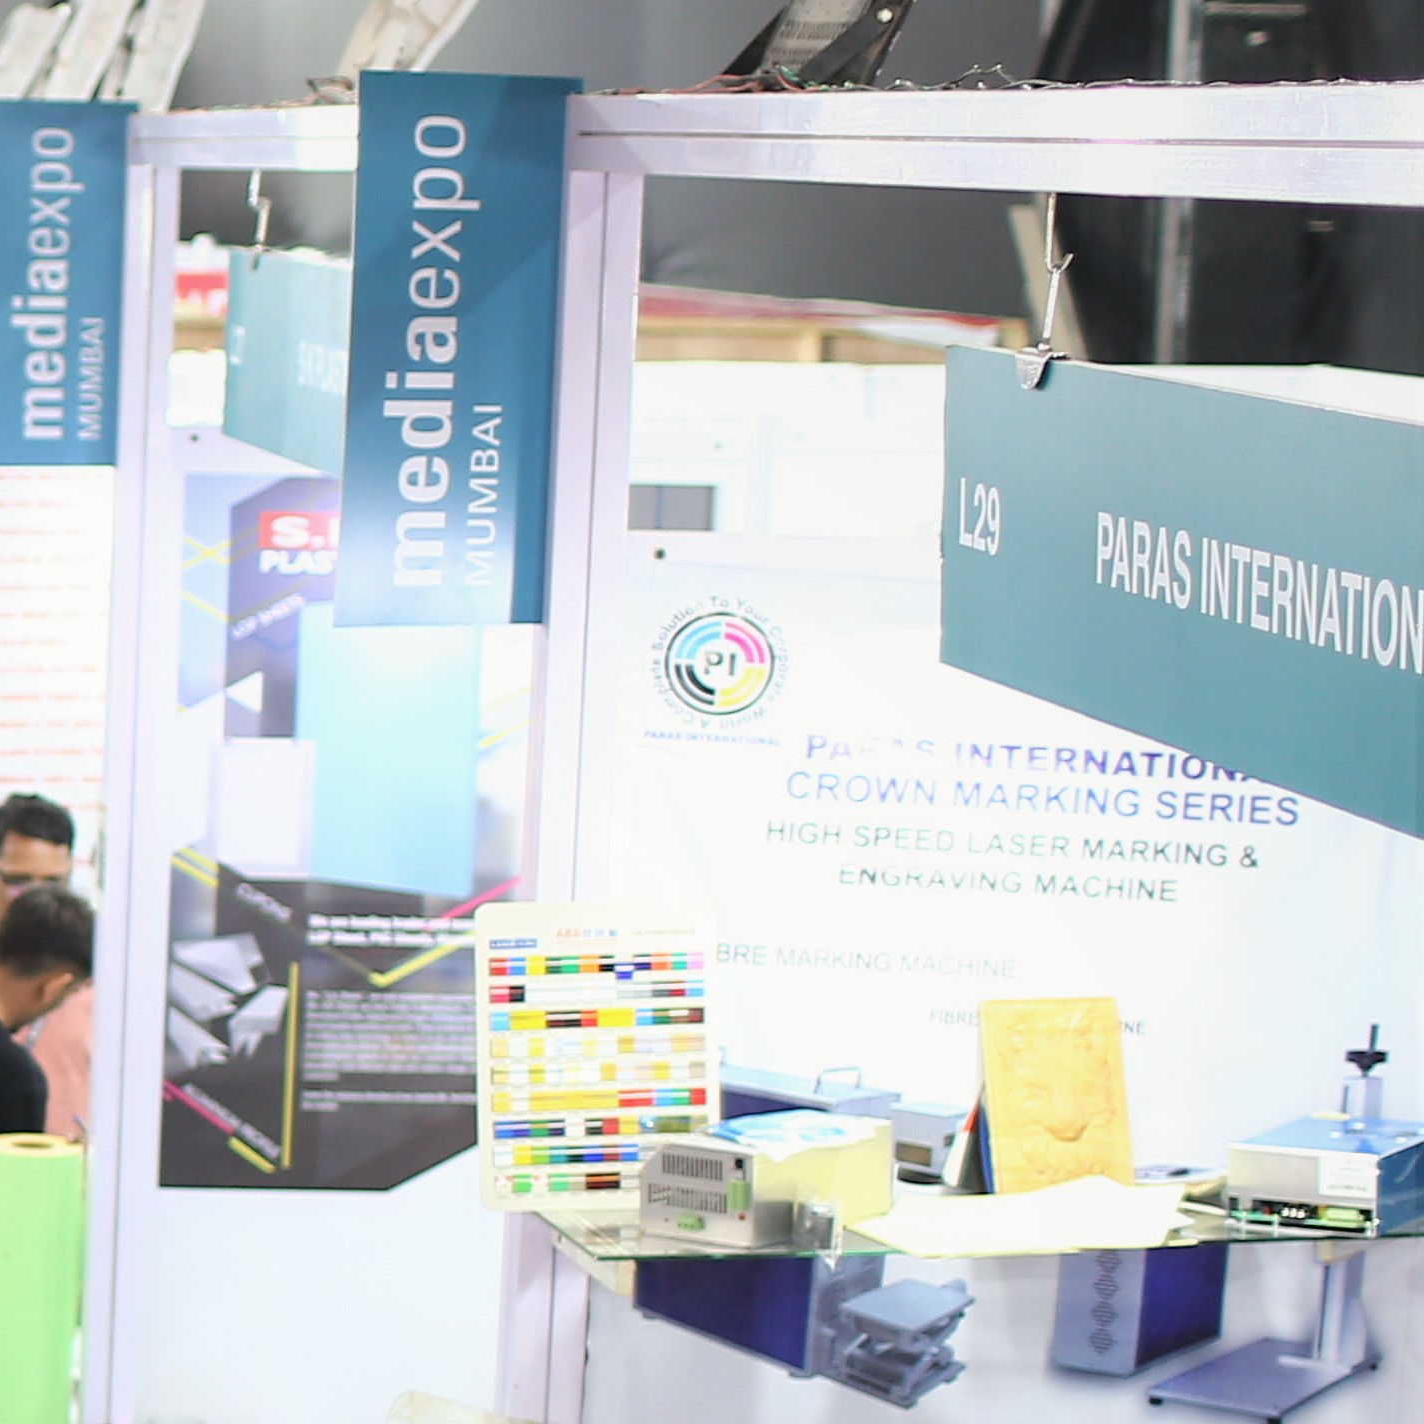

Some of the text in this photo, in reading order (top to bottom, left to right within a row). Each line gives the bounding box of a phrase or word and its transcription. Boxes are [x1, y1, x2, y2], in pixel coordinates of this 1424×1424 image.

[12, 127, 85, 441] mediaexpo
[79, 316, 105, 441] MUMBAI
[385, 113, 480, 590] mediaexpo
[465, 404, 503, 588] MUMBAI
[959, 477, 1001, 556] L29
[1096, 511, 1191, 609] PARAS
[703, 651, 736, 677] PI
[786, 771, 1300, 826] CROWN MARKING SERIES
[766, 820, 1259, 869] HIGH SPEED LASER MARKING &
[839, 862, 1179, 902] ENGRAVING MACHINE
[716, 942, 1016, 980] BRE MARKING MACHINE
